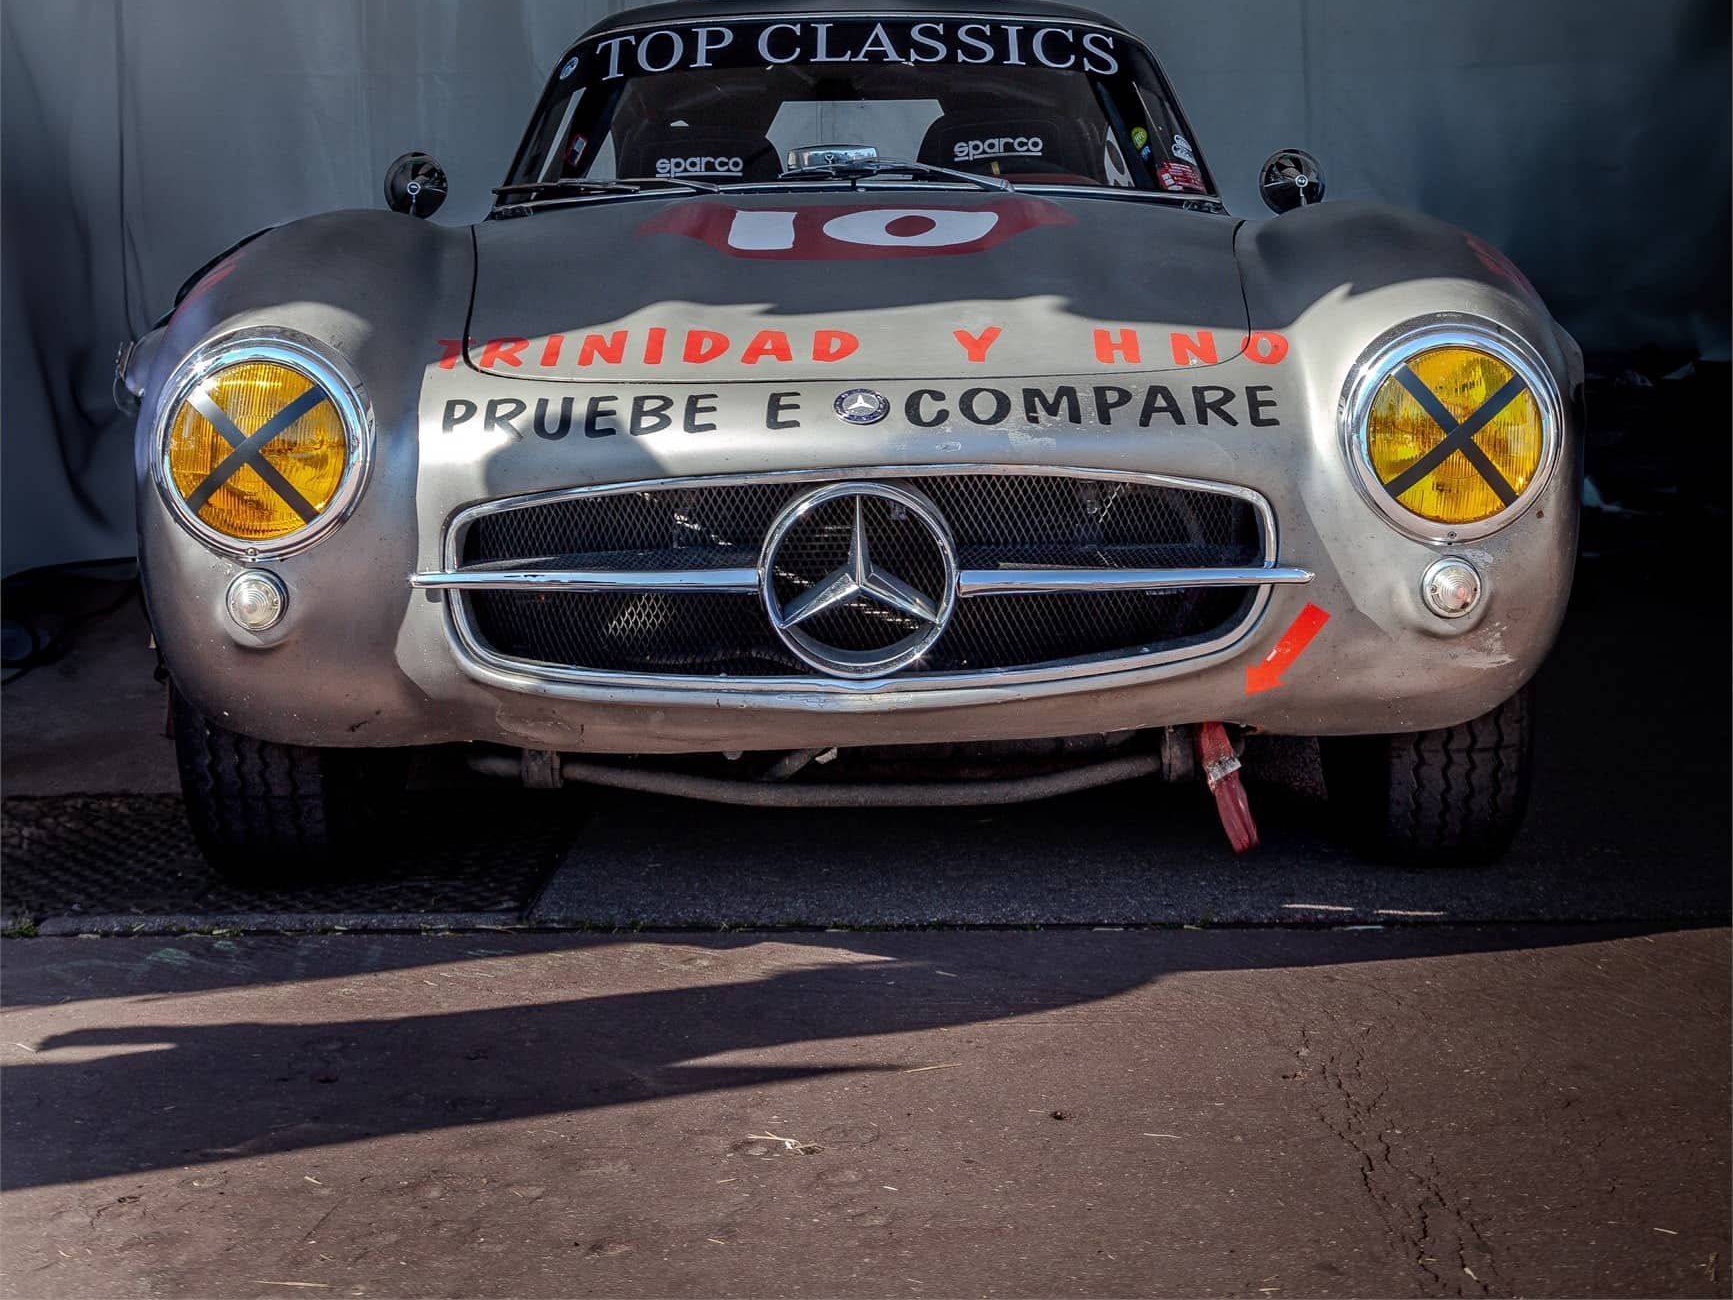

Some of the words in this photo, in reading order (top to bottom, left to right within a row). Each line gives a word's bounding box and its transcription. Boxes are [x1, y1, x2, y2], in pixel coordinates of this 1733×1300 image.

[596, 26, 734, 81] TOP
[758, 22, 1119, 76] CLASSICS
[655, 155, 743, 177] sparco
[953, 136, 1043, 162] sparco
[727, 208, 999, 251] 10
[436, 326, 860, 370] TRINIDAD
[952, 326, 1003, 363] Y
[1092, 328, 1289, 366] HNO
[441, 393, 719, 441] PRUEBE
[766, 391, 801, 430] E
[904, 385, 1281, 428] COMPARE
